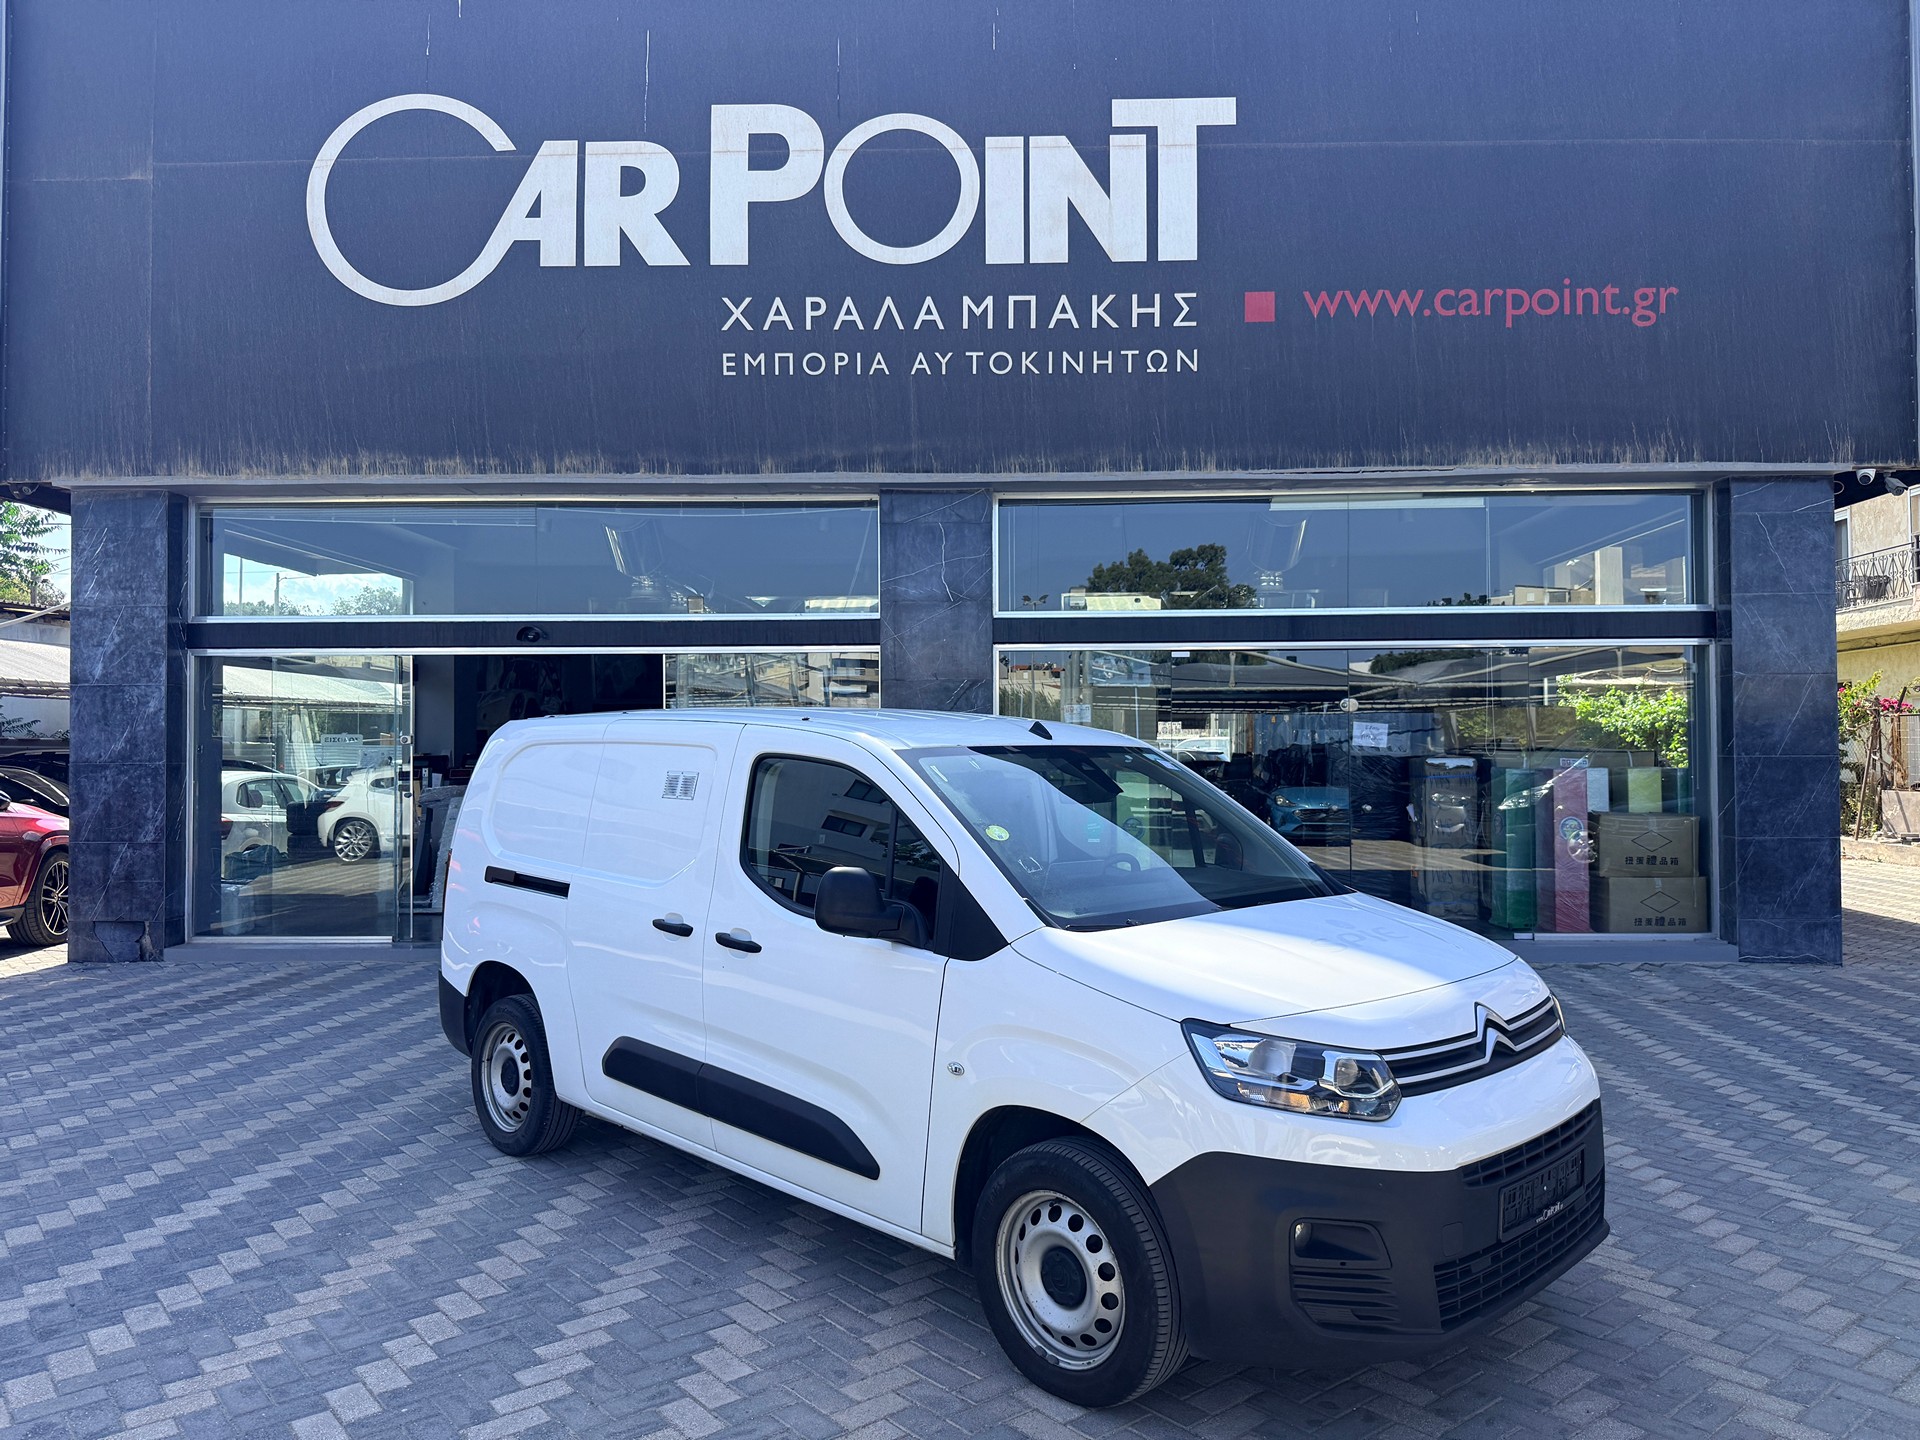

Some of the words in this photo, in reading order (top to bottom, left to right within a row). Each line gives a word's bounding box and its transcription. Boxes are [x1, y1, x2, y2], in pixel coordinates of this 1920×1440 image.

[1303, 279, 1678, 328] www.carpoint.gr
[722, 352, 889, 376] ΕΜΠΟΡΙΑ
[911, 348, 1199, 375] ΑΥΤΟΚΙΝΗΤΩΝ
